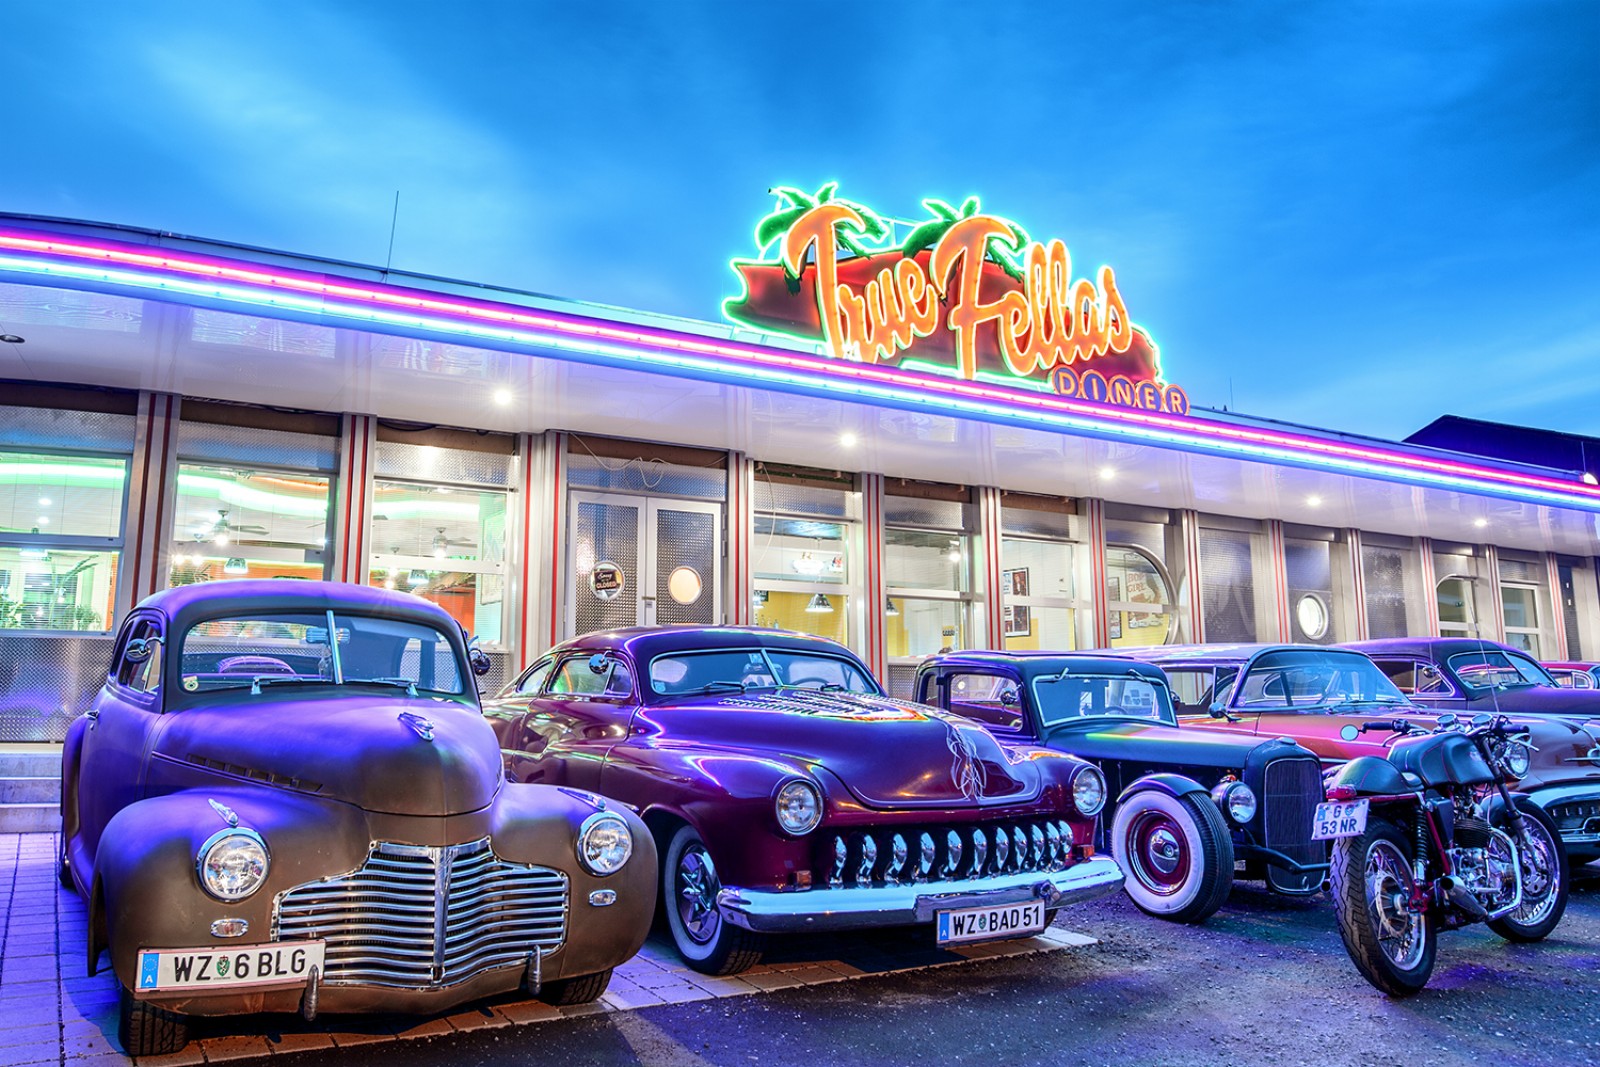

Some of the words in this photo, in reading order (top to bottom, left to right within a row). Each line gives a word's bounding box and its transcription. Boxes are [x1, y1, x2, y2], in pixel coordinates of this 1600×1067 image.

[785, 204, 938, 365] True
[931, 215, 1131, 379] Fellas
[1057, 371, 1184, 414] DINER
[596, 581, 616, 589] CLOSED
[1321, 820, 1337, 835] 53
[1340, 818, 1357, 833] NR
[953, 914, 976, 936] WZ
[989, 909, 1019, 932] BAD
[1023, 905, 1040, 926] 51
[144, 974, 154, 984] A
[174, 955, 213, 982] WZ
[234, 953, 250, 979] 6
[257, 949, 305, 977] BLG
